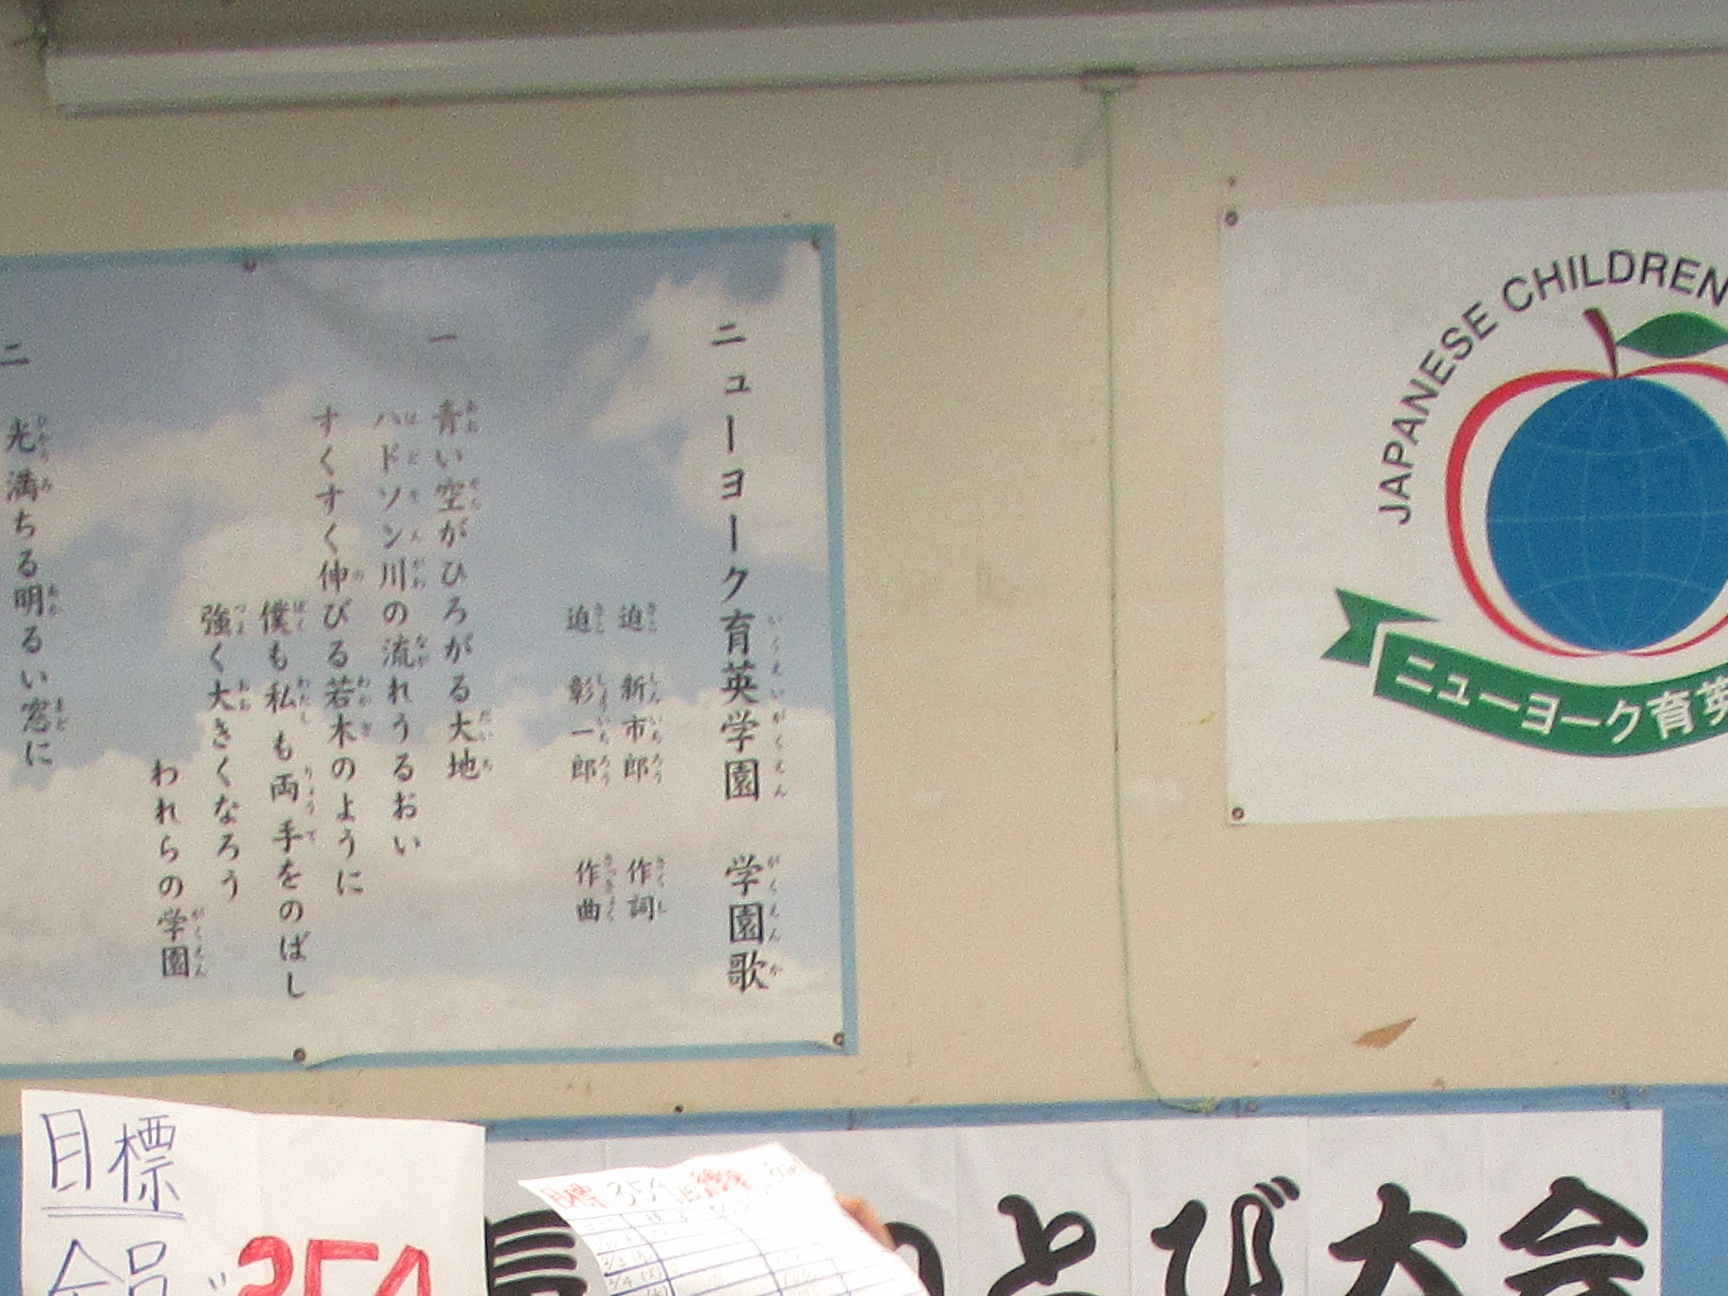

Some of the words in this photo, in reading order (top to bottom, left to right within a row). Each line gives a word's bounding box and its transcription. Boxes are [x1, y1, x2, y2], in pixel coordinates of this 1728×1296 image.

[1377, 300, 1498, 525] JAPANESE
[709, 322, 761, 802] ニューヨーク育英学園
[200, 603, 241, 900] 強く大きくなろう
[259, 599, 311, 1000] 僕も私も両手をのばし
[151, 758, 190, 979] われらの学園
[574, 857, 602, 923] 作曲
[626, 856, 656, 922] 作詞
[725, 853, 769, 994] 学園歌
[41, 1109, 181, 1211] 目標
